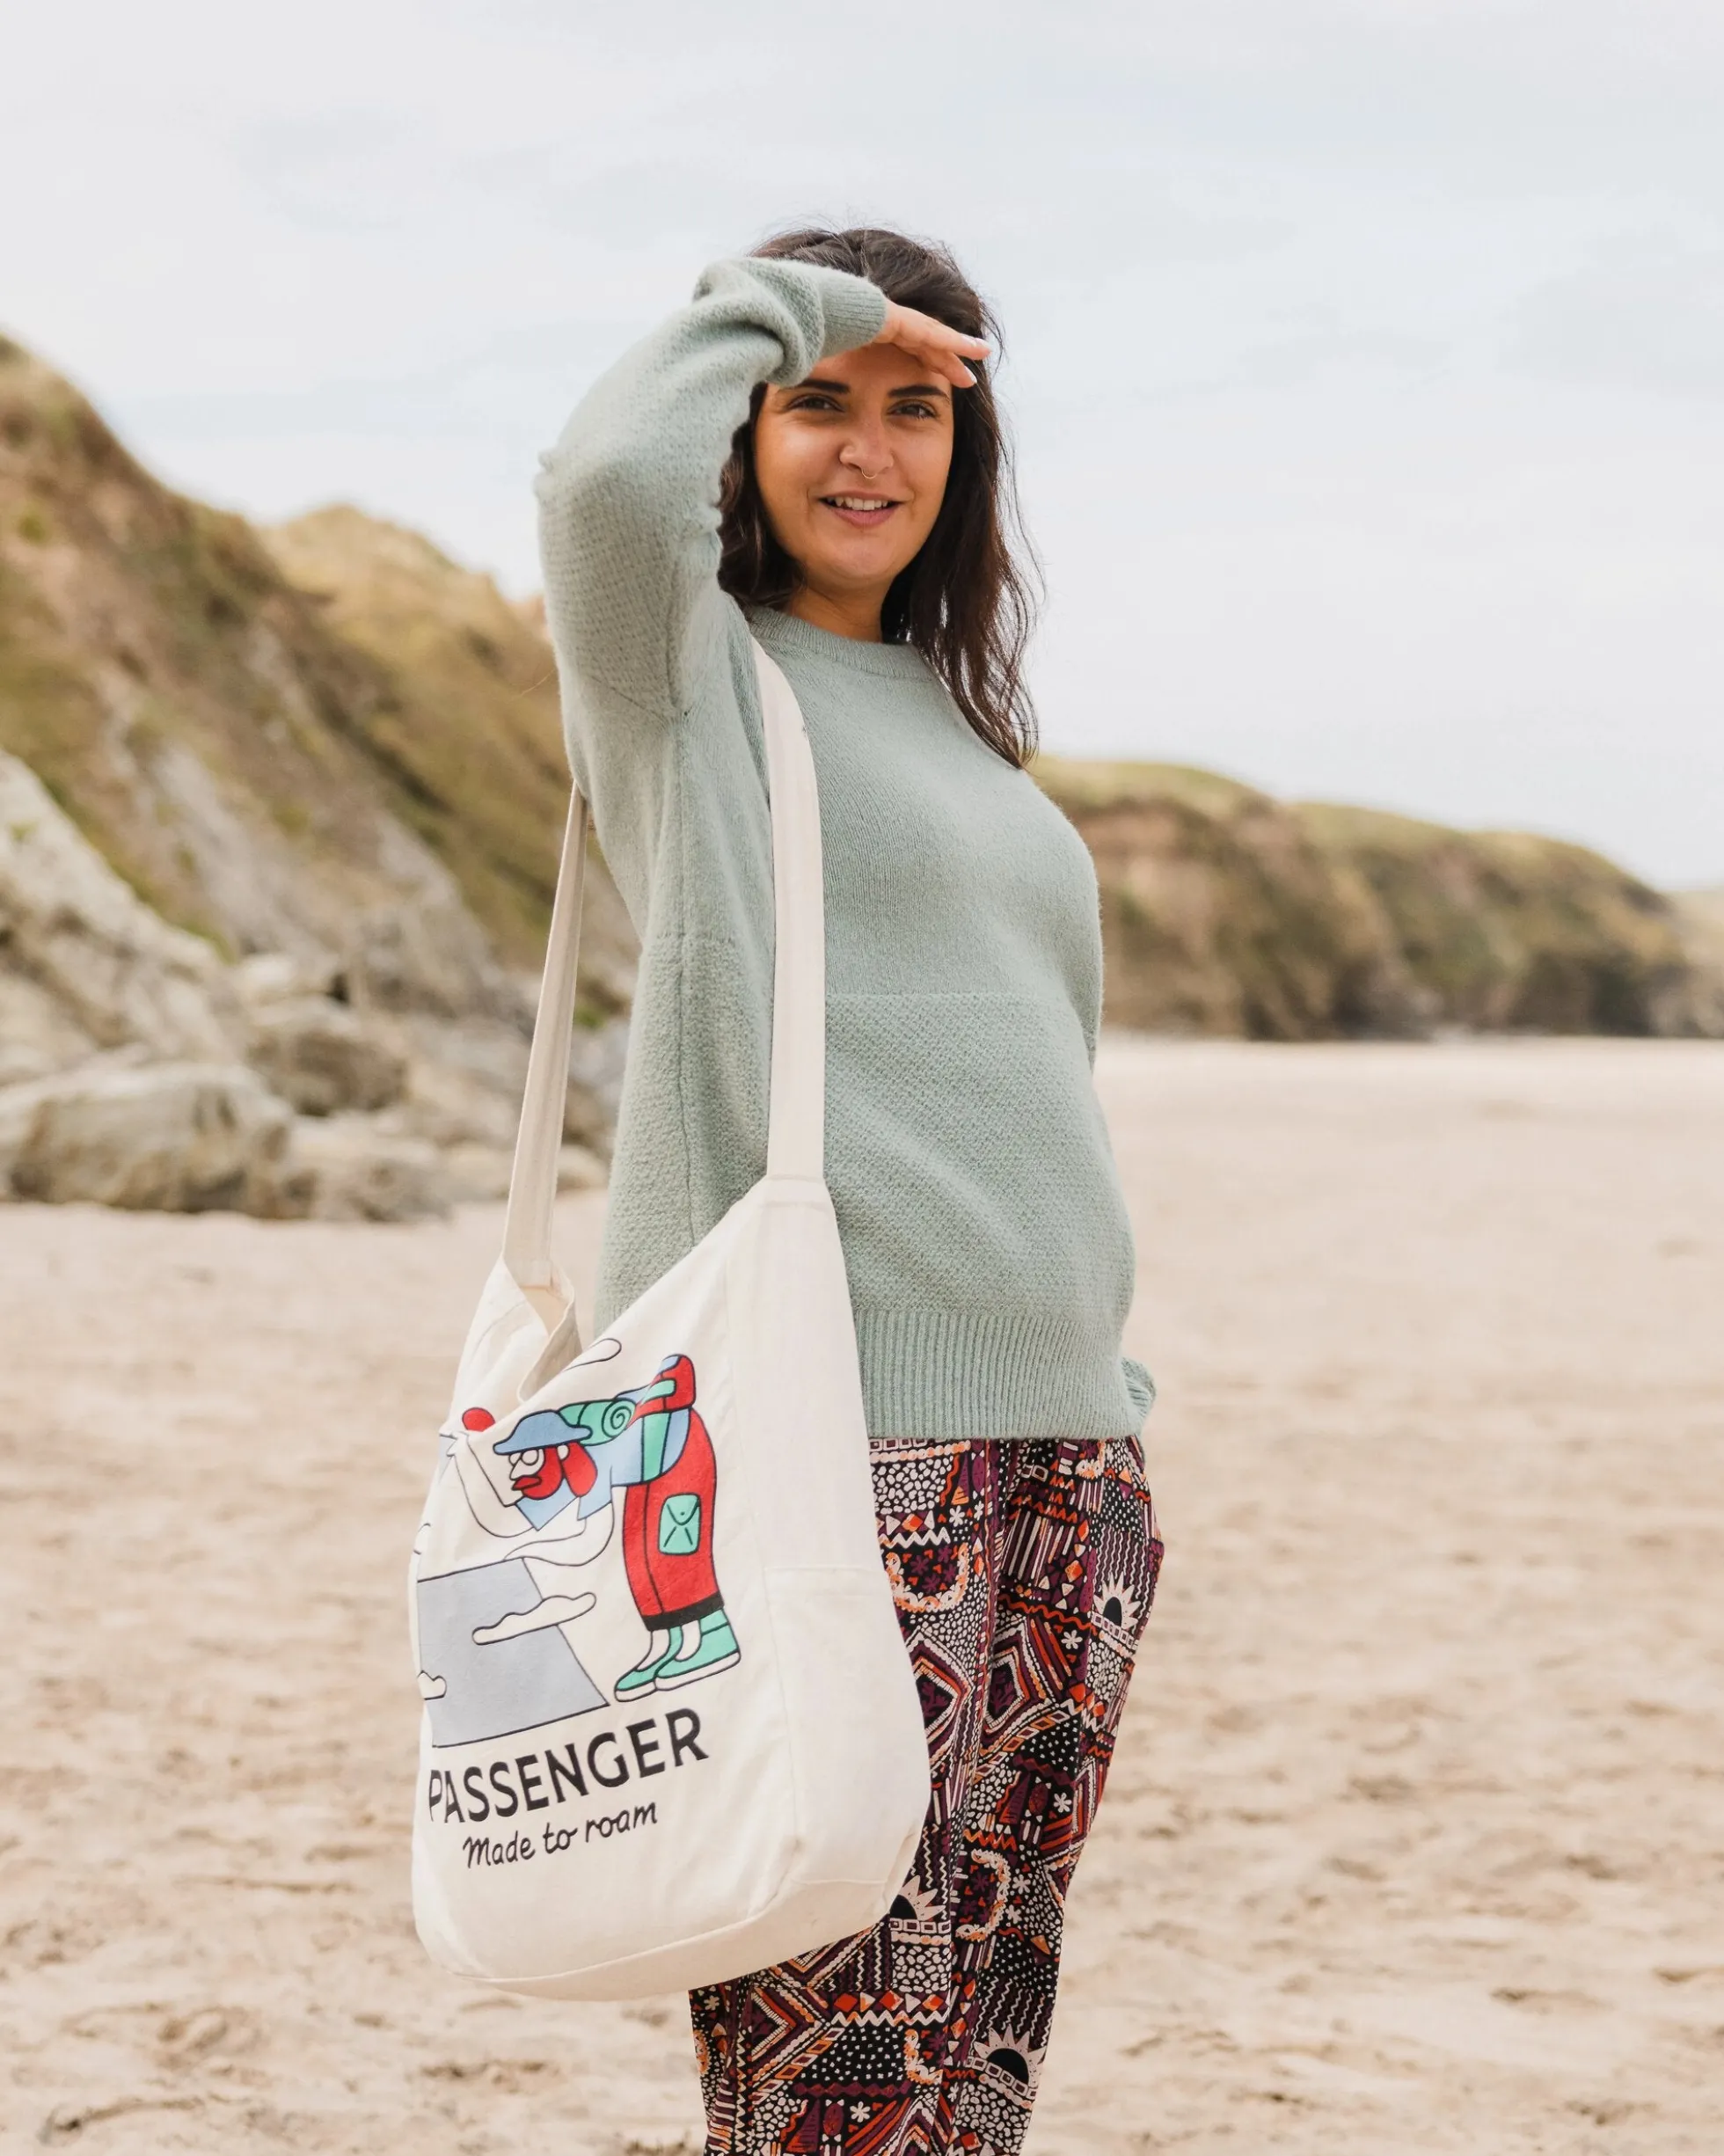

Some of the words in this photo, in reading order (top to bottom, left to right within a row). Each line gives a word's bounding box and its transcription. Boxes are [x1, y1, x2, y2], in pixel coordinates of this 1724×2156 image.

[428, 1708, 709, 1823] PASSENGER
[463, 1831, 536, 1868] Made
[543, 1822, 578, 1854] to
[585, 1802, 658, 1842] roam
